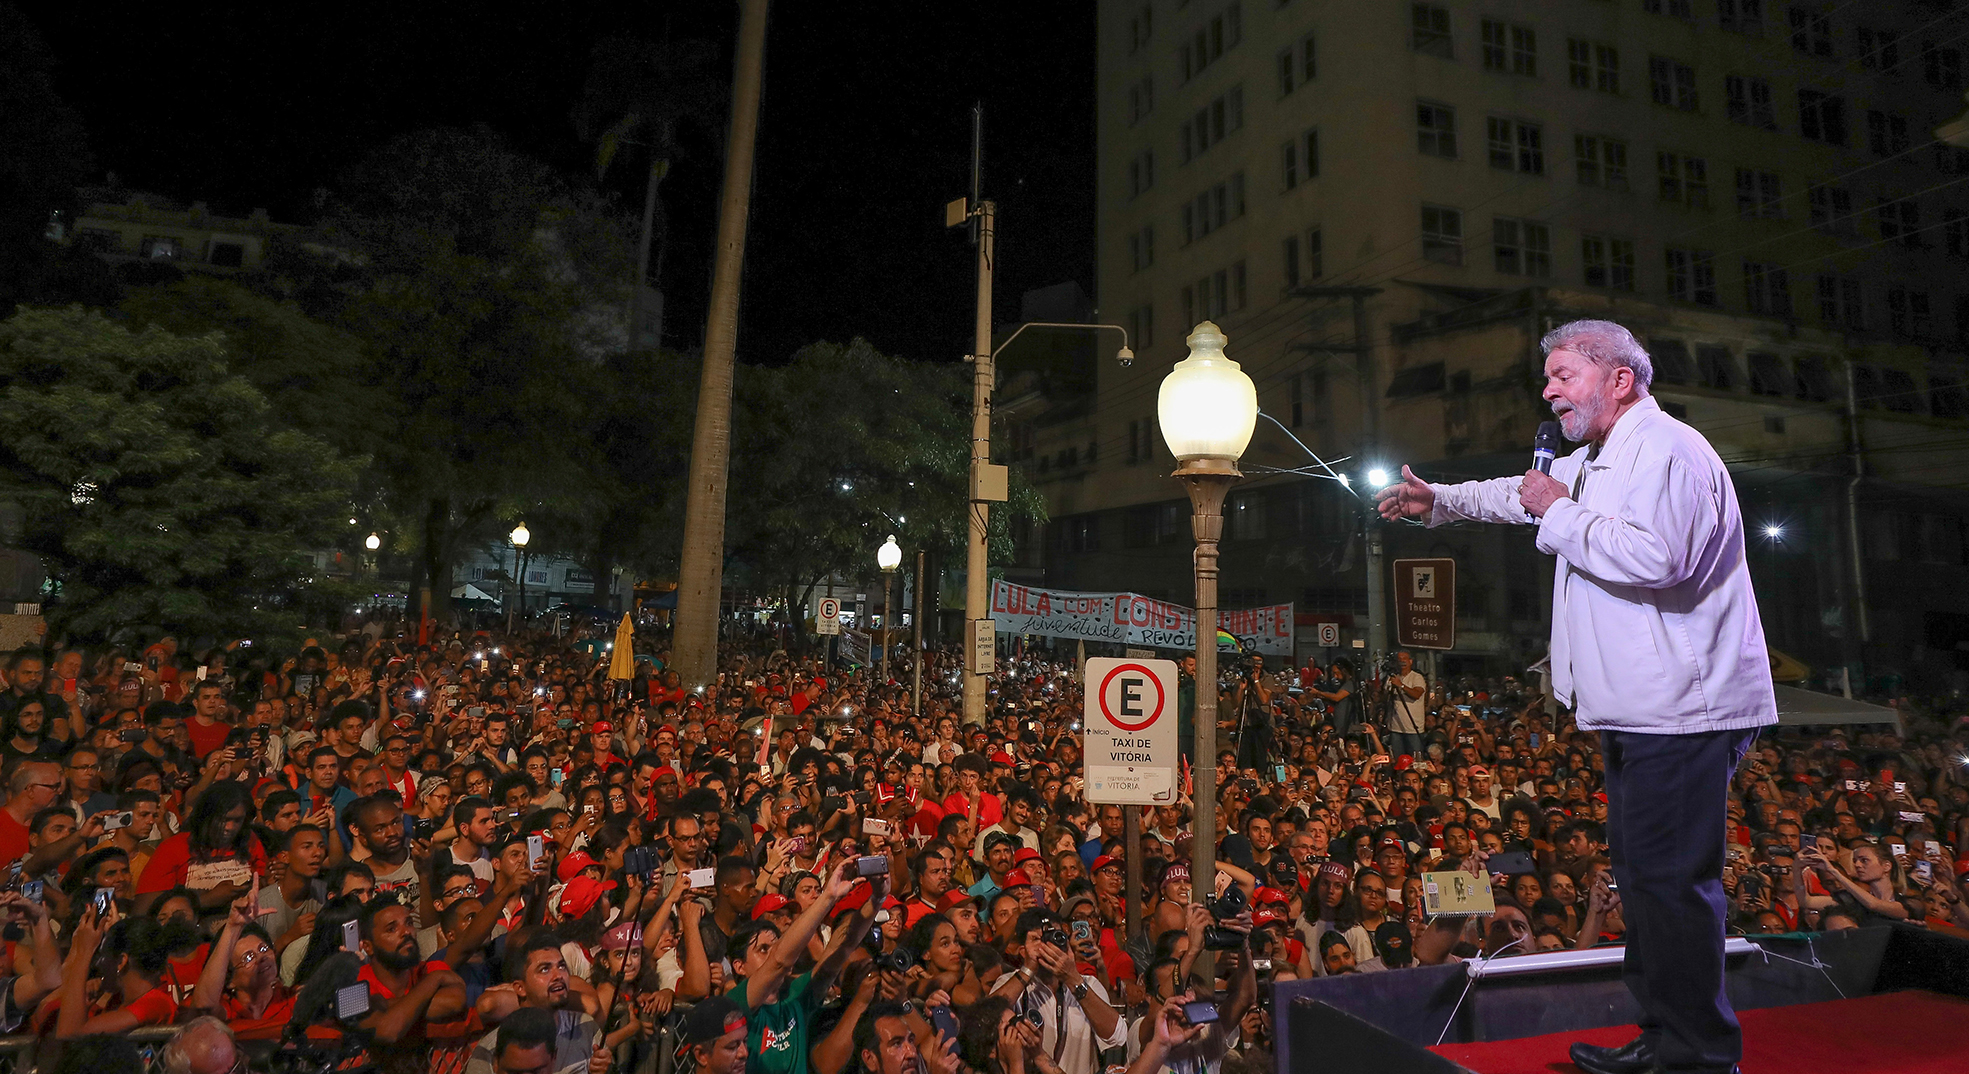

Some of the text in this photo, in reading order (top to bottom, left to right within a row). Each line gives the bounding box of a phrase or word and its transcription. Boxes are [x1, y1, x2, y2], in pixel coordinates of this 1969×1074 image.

[993, 582, 1051, 617] LULA
[1064, 598, 1102, 615] COM
[826, 604, 833, 615] E
[1408, 602, 1440, 612] Theatro
[1412, 617, 1438, 627] Carlos
[1326, 629, 1331, 639] E
[1412, 631, 1438, 641] Gomes
[1121, 678, 1143, 716] E
[1092, 728, 1110, 736] INÍCIO
[1112, 738, 1151, 748] TAXI DE
[1110, 751, 1152, 762] VITÓRIA
[1107, 781, 1140, 790] VITÓRIA
[1324, 865, 1344, 877] LULA
